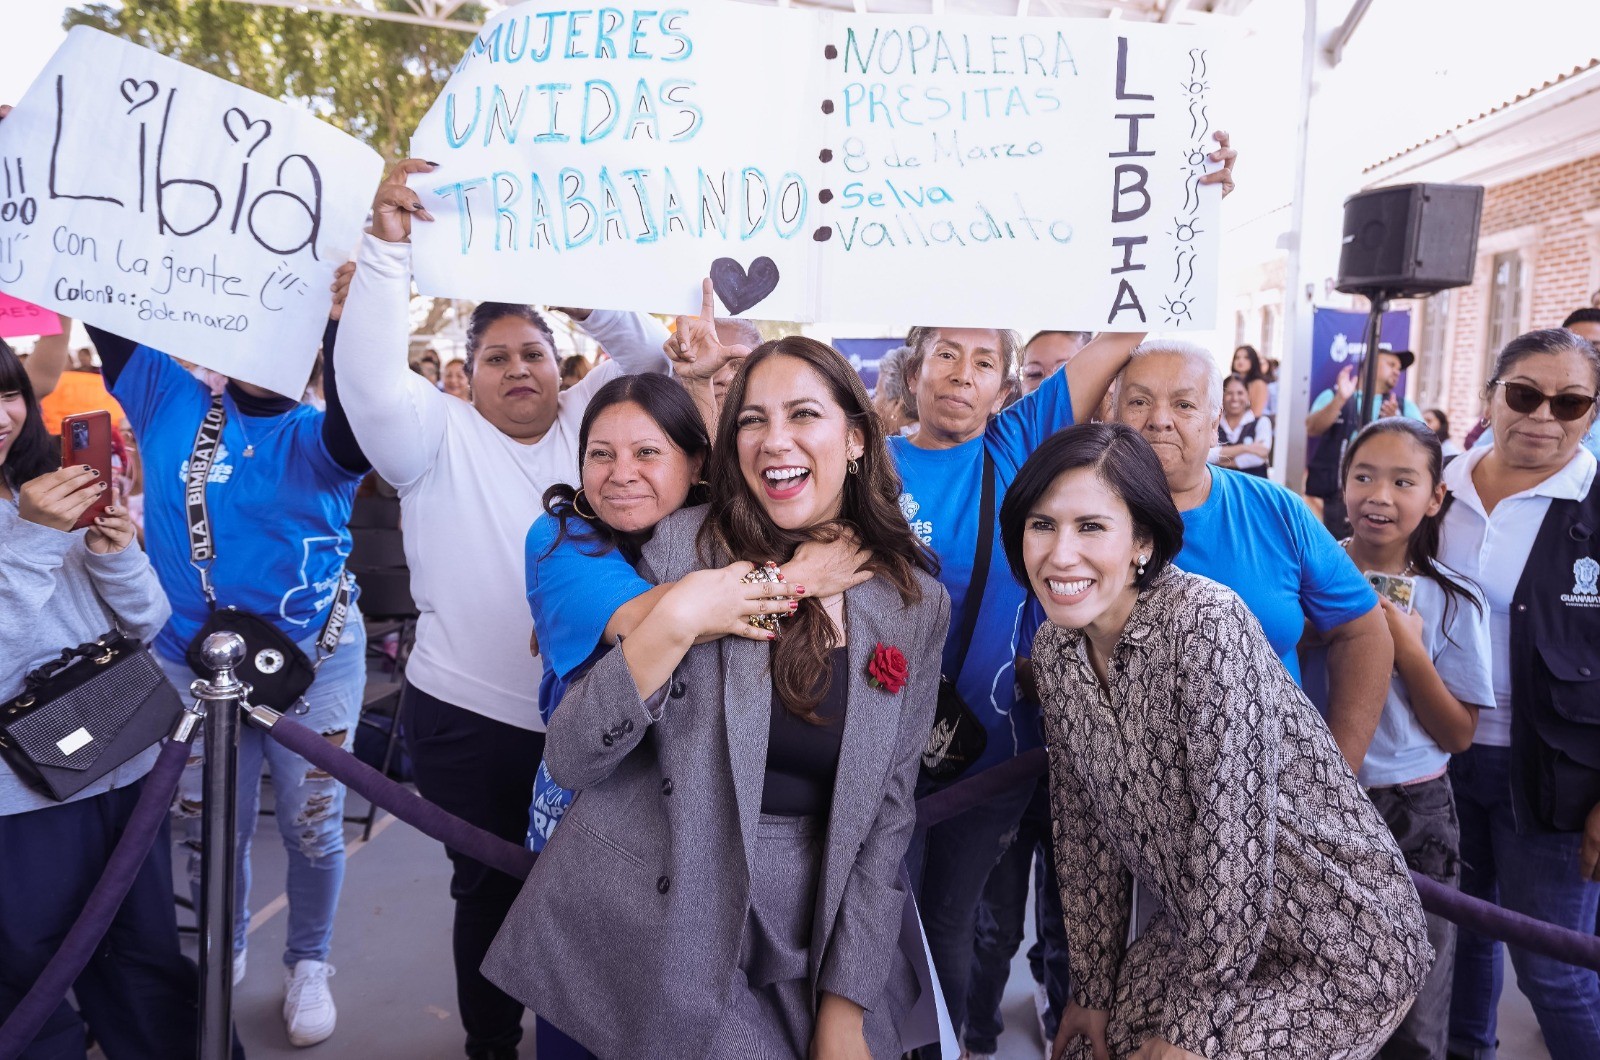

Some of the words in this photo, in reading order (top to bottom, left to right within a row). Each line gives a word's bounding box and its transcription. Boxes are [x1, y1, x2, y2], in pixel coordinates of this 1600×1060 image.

[455, 7, 693, 74] MUJERES
[844, 25, 1078, 78] NOPALERA
[445, 77, 703, 149] UNIDAS
[842, 82, 1061, 128] PRESITAS
[49, 74, 322, 262] Libia
[842, 136, 870, 174] 8
[884, 138, 920, 168] de
[932, 129, 1043, 168] Marzo
[841, 178, 955, 209] Selva
[1107, 36, 1157, 324] LIBIA
[835, 192, 1073, 251] Valladito
[150, 253, 250, 297] gente
